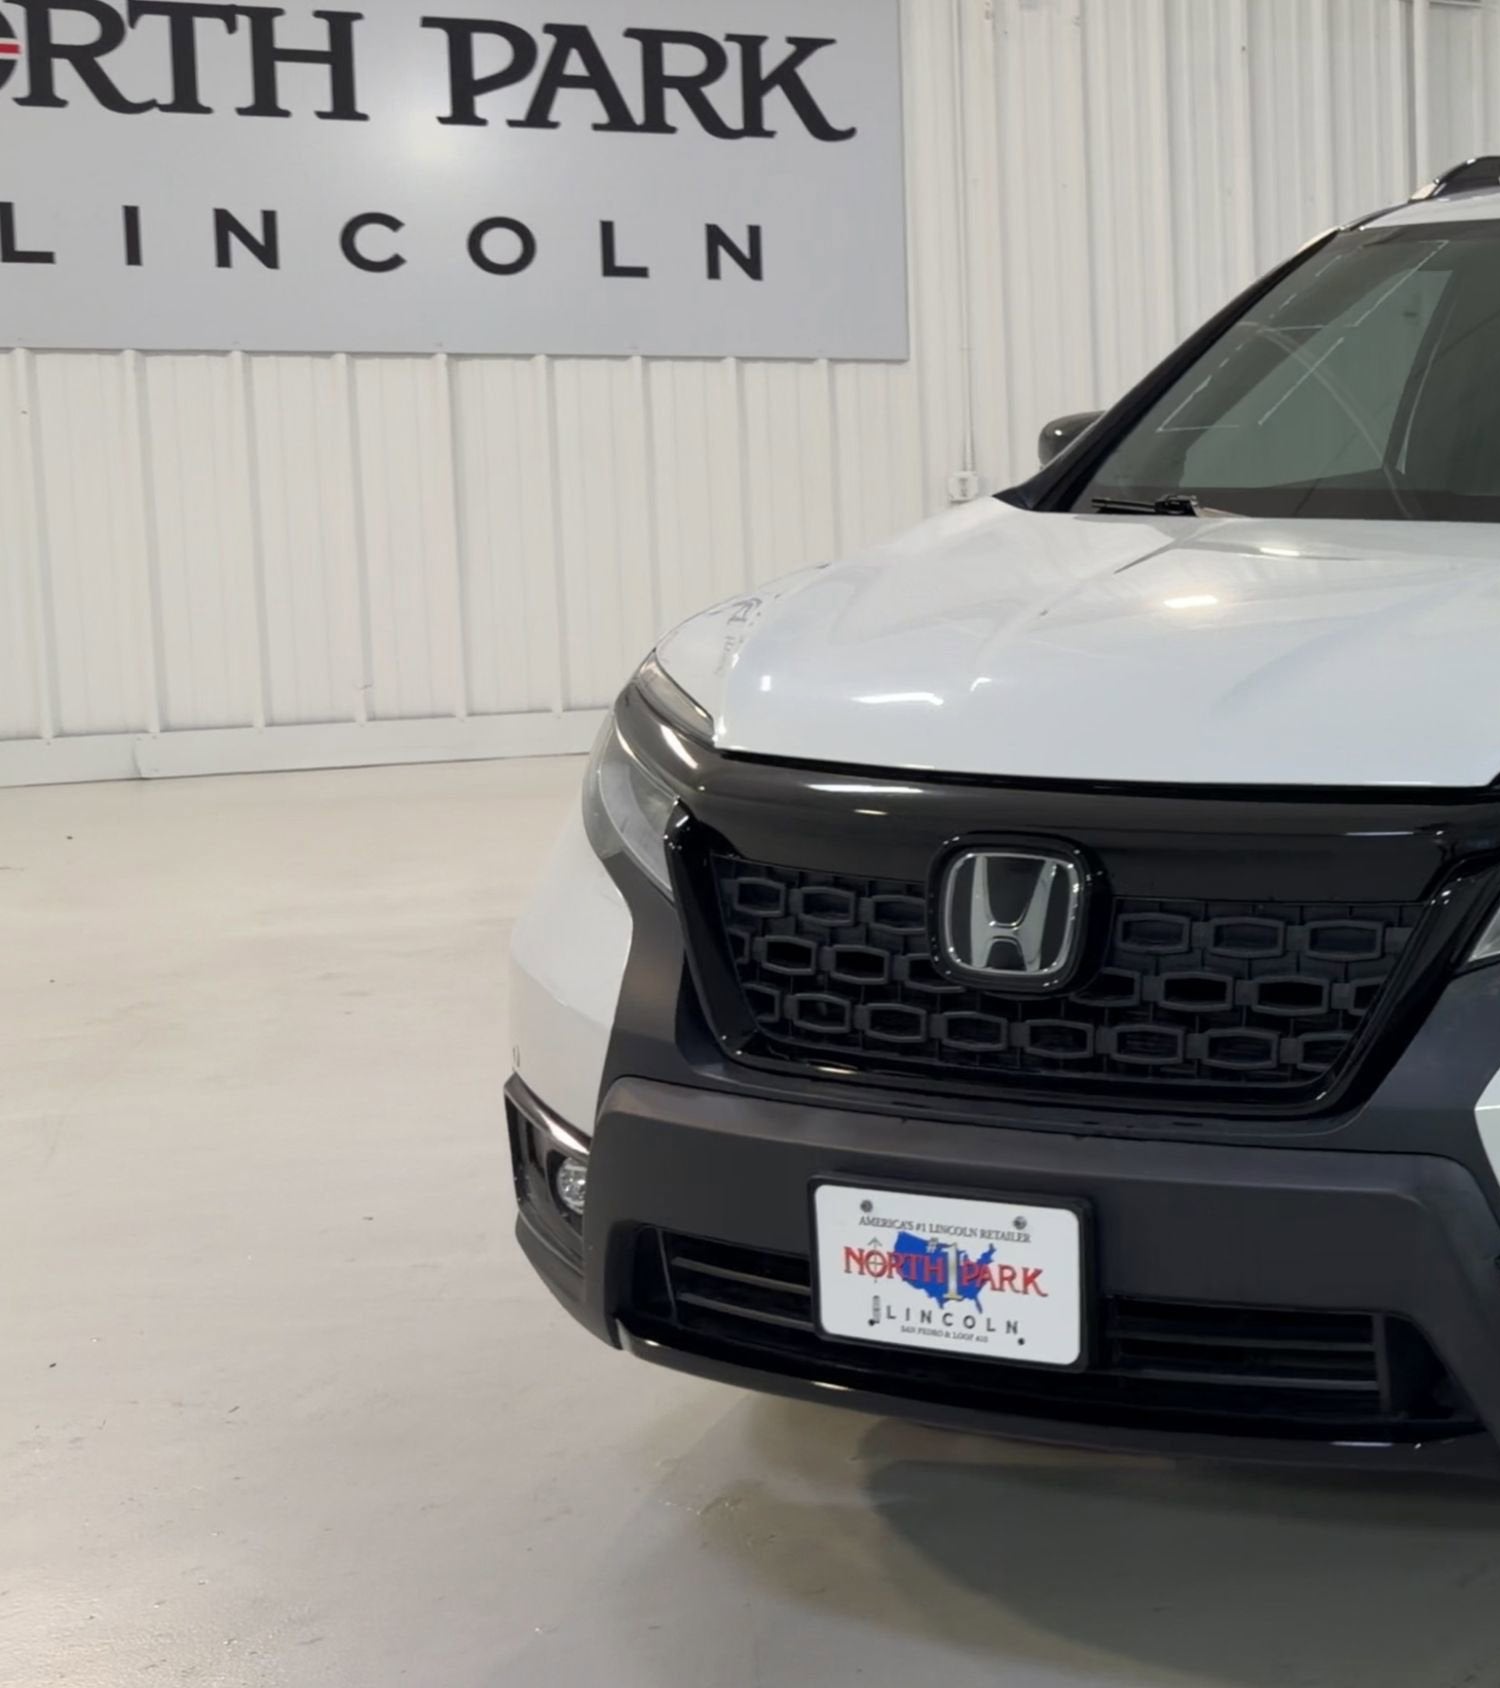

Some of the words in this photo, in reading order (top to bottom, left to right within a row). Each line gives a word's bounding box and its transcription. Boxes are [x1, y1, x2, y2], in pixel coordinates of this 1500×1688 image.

[0, 0, 369, 121] RTH
[420, 16, 856, 142] PARK
[0, 202, 764, 281] LINCOLN
[859, 1215, 914, 1230] AMERICA'S
[915, 1222, 927, 1232] #1
[928, 1223, 978, 1237] LINCOLN
[979, 1228, 1032, 1243] RETAILER
[844, 1246, 945, 1284] NORTH
[962, 1258, 1049, 1298] PARK
[886, 1305, 1018, 1335] LINCOLN
[900, 1325, 916, 1334] SAN
[917, 1326, 943, 1337] PEDRO
